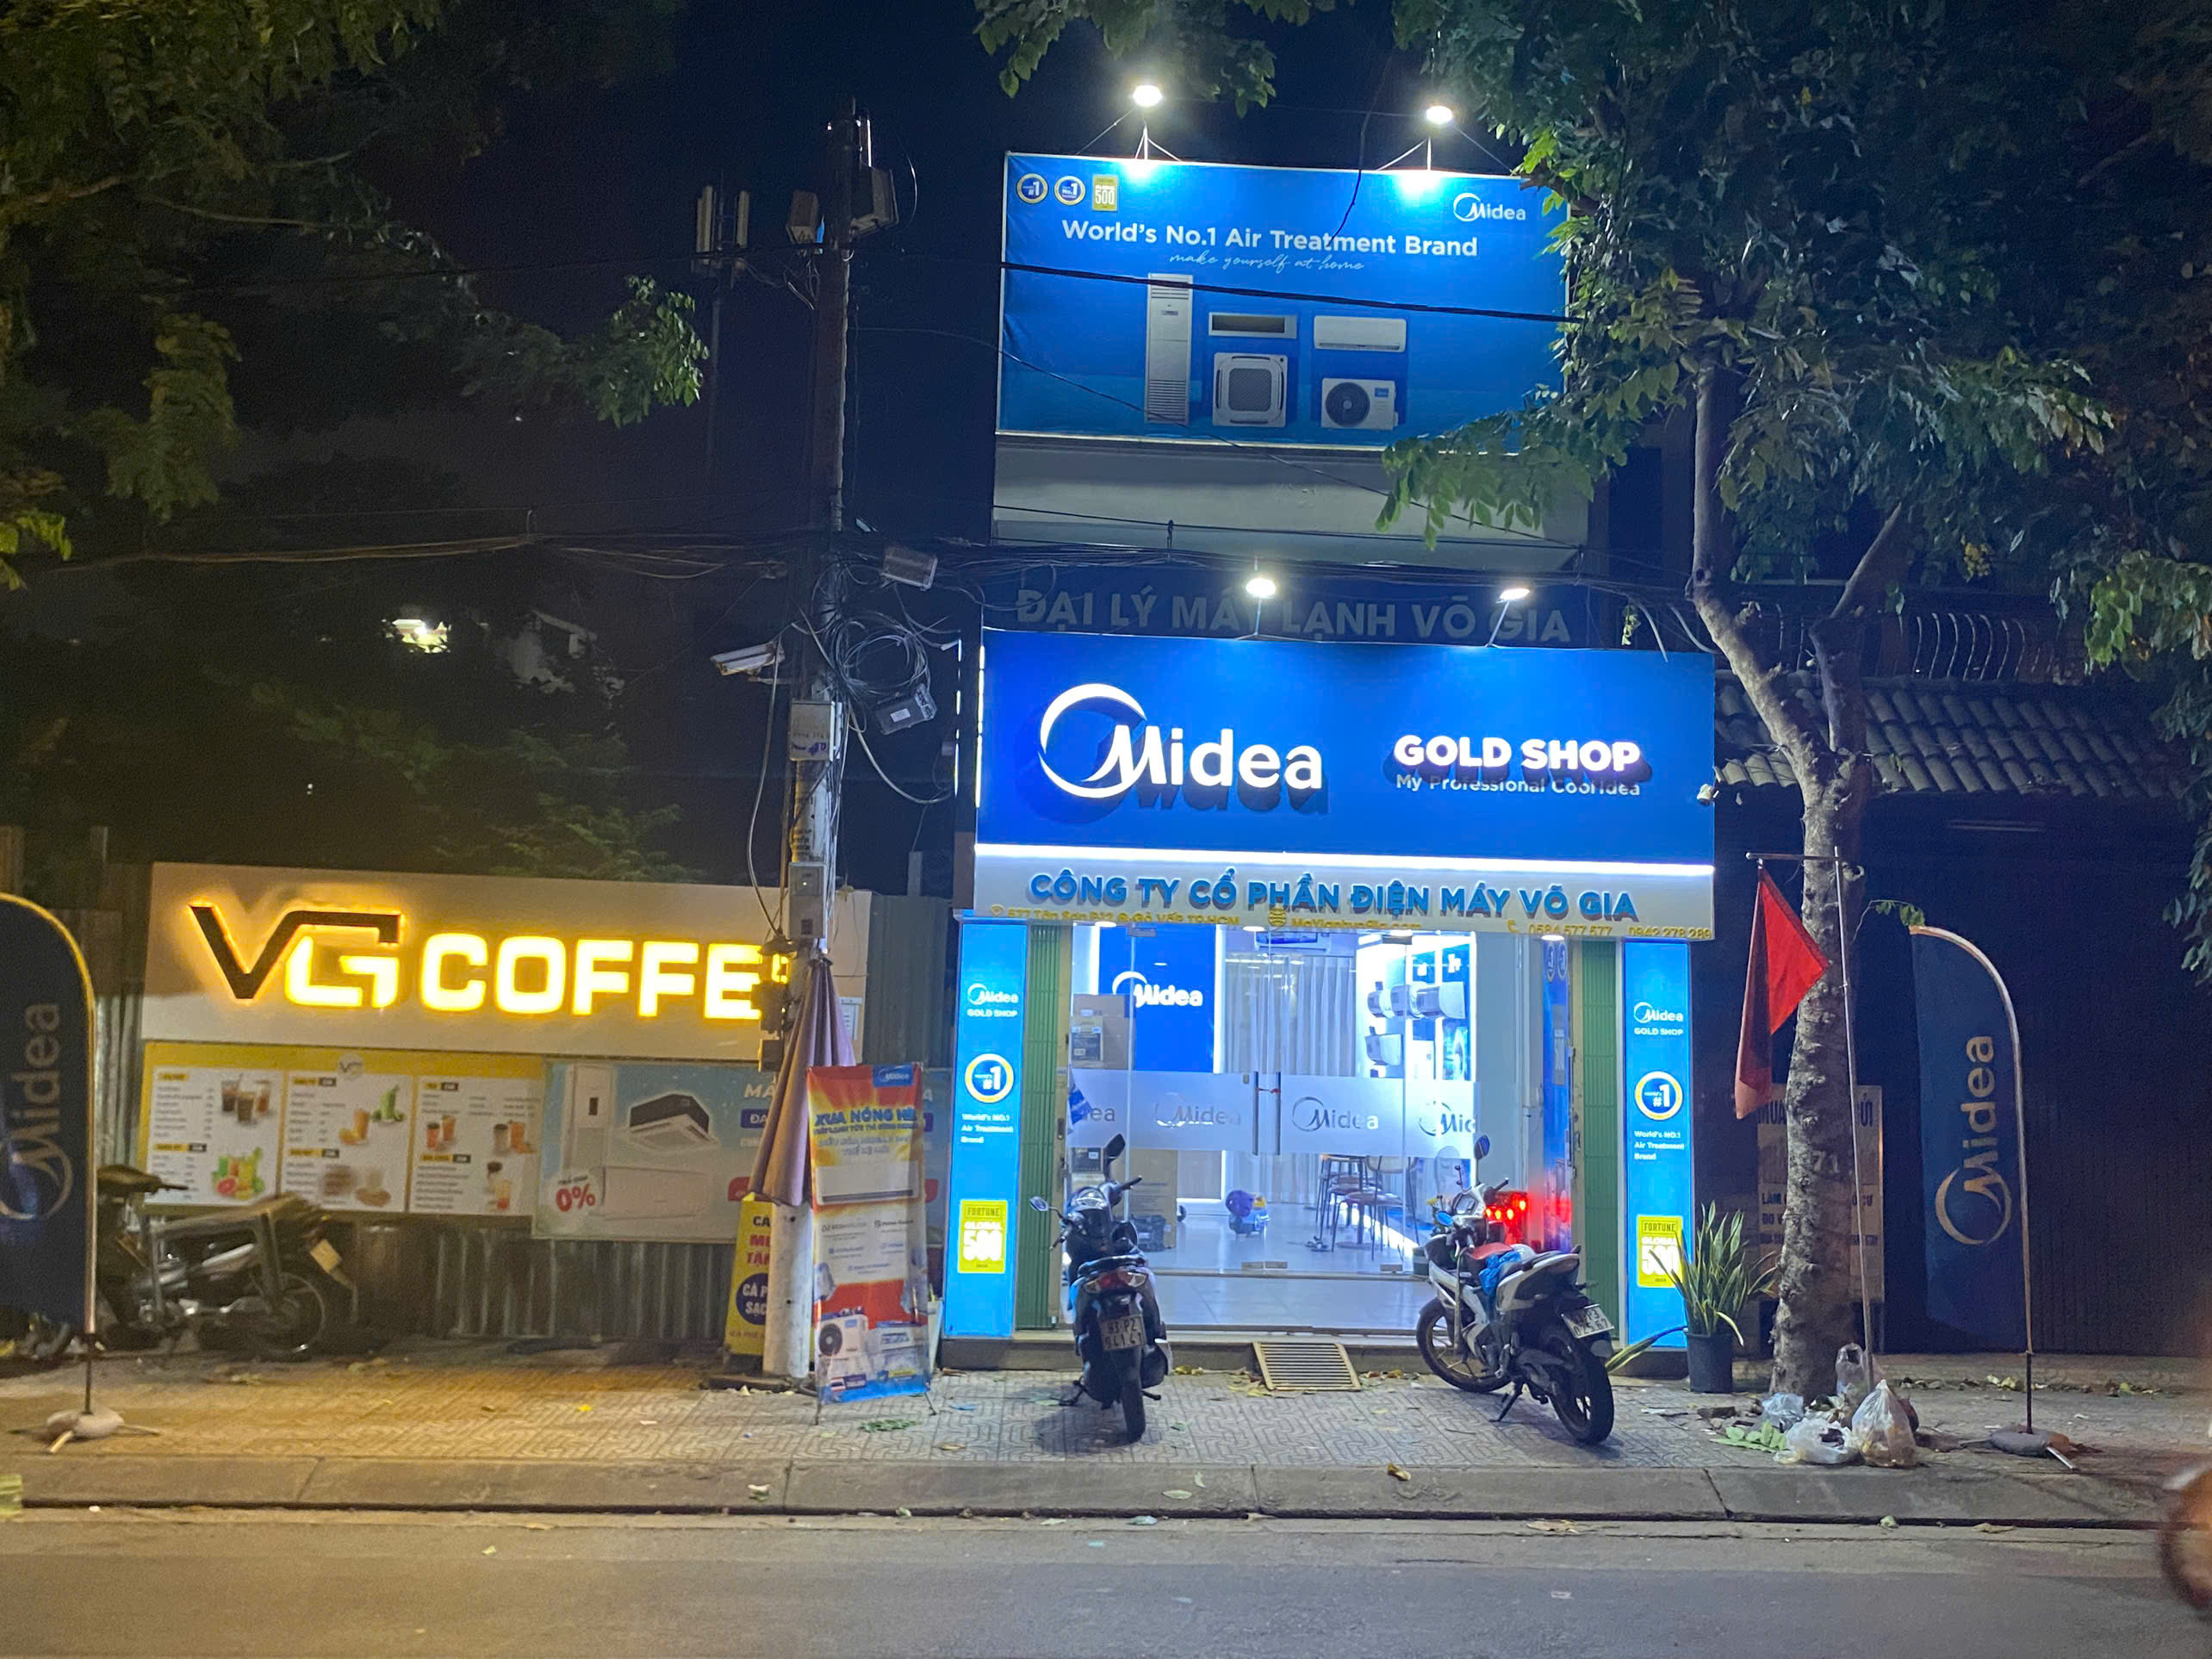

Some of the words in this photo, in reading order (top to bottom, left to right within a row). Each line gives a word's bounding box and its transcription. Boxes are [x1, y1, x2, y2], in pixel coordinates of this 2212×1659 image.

[1095, 190, 1115, 205] 500
[1454, 200, 1526, 221] Midea
[1166, 225, 1216, 246] No.1
[1225, 228, 1262, 248] Air
[1270, 230, 1396, 254] Treatment
[1405, 234, 1478, 257] Brand
[1169, 249, 1219, 265] make
[1222, 253, 1291, 274] yourself
[1319, 254, 1365, 270] home
[1110, 585, 1158, 628] LÝ
[1282, 601, 1396, 642] LẠNH
[1489, 603, 1570, 643] GIA
[1038, 724, 1323, 798] Midea
[1394, 734, 1513, 768] GOLD
[1520, 738, 1641, 773] SHOP
[1395, 774, 1423, 791] My
[1429, 776, 1545, 793] Professional
[1029, 868, 1128, 904] CÔNG
[1136, 877, 1181, 904] TY
[1189, 867, 1238, 905] CỔ
[1248, 872, 1339, 910] PHẦN
[1351, 879, 1430, 916] ĐIỆN
[1439, 880, 1510, 913] MÁY
[1518, 884, 1569, 916] VÕ
[1578, 890, 1639, 919] GIA
[1529, 923, 1560, 935] 0584
[1563, 925, 1586, 936] 577
[1589, 925, 1612, 937] 577
[189, 902, 402, 1008] VG
[968, 989, 1019, 1005] Midea
[1129, 982, 1203, 1008] Midea
[1634, 1009, 1684, 1023] Midea
[1634, 1027, 1659, 1035] GOLD
[1660, 1028, 1684, 1036] SHOP
[9, 1003, 73, 1213] Midea
[1961, 1035, 2011, 1244] Midea
[555, 1184, 597, 1212] 0%
[1643, 1222, 1675, 1232] FORTUNE
[962, 1229, 1003, 1261] 500
[1641, 1245, 1680, 1276] 500
[745, 1302, 767, 1317] SẠC
